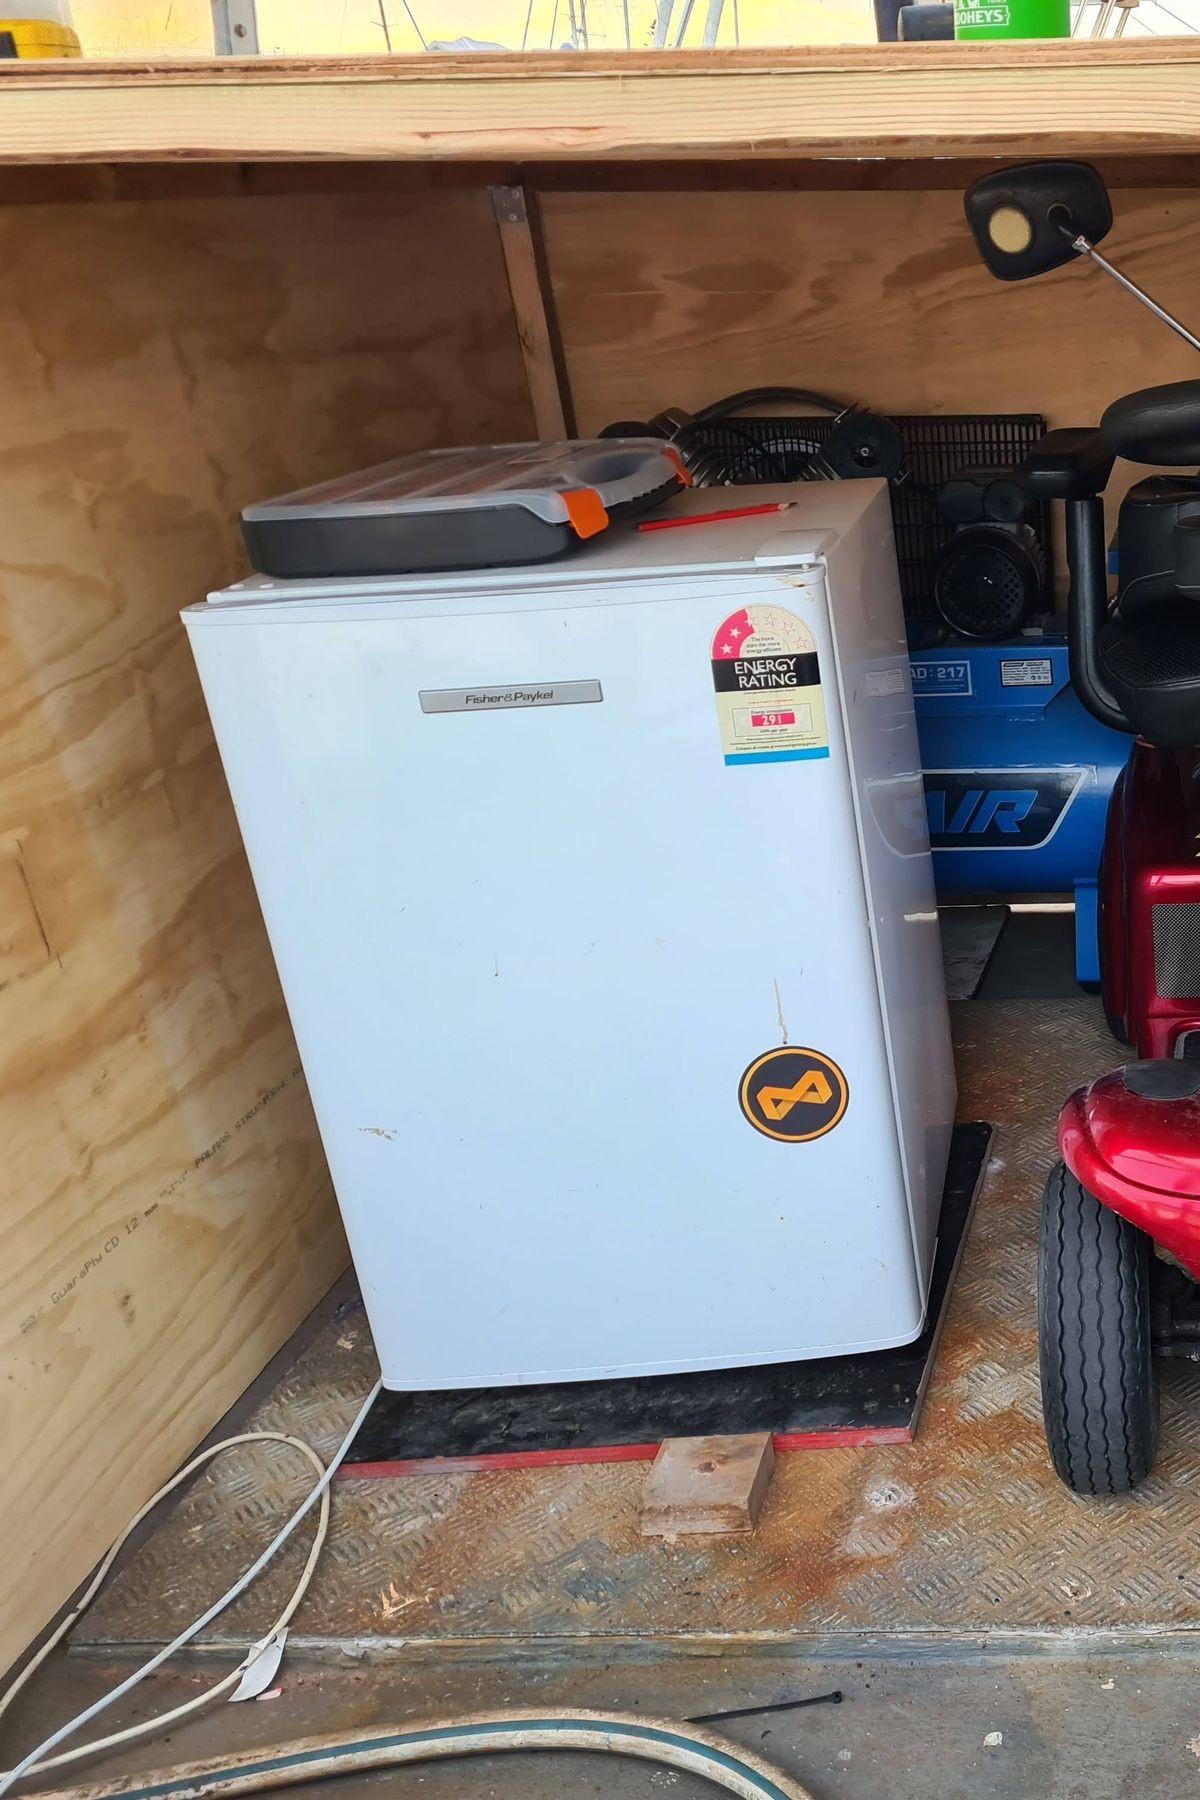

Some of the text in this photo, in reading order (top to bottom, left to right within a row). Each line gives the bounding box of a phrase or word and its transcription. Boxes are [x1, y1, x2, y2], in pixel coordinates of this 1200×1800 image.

[734, 658, 797, 675] ENERGY
[738, 672, 797, 689] RATING
[761, 714, 782, 726] 291
[50, 1253, 103, 1304] GuaraPly
[103, 1236, 120, 1254] CD
[125, 1216, 139, 1235] 12
